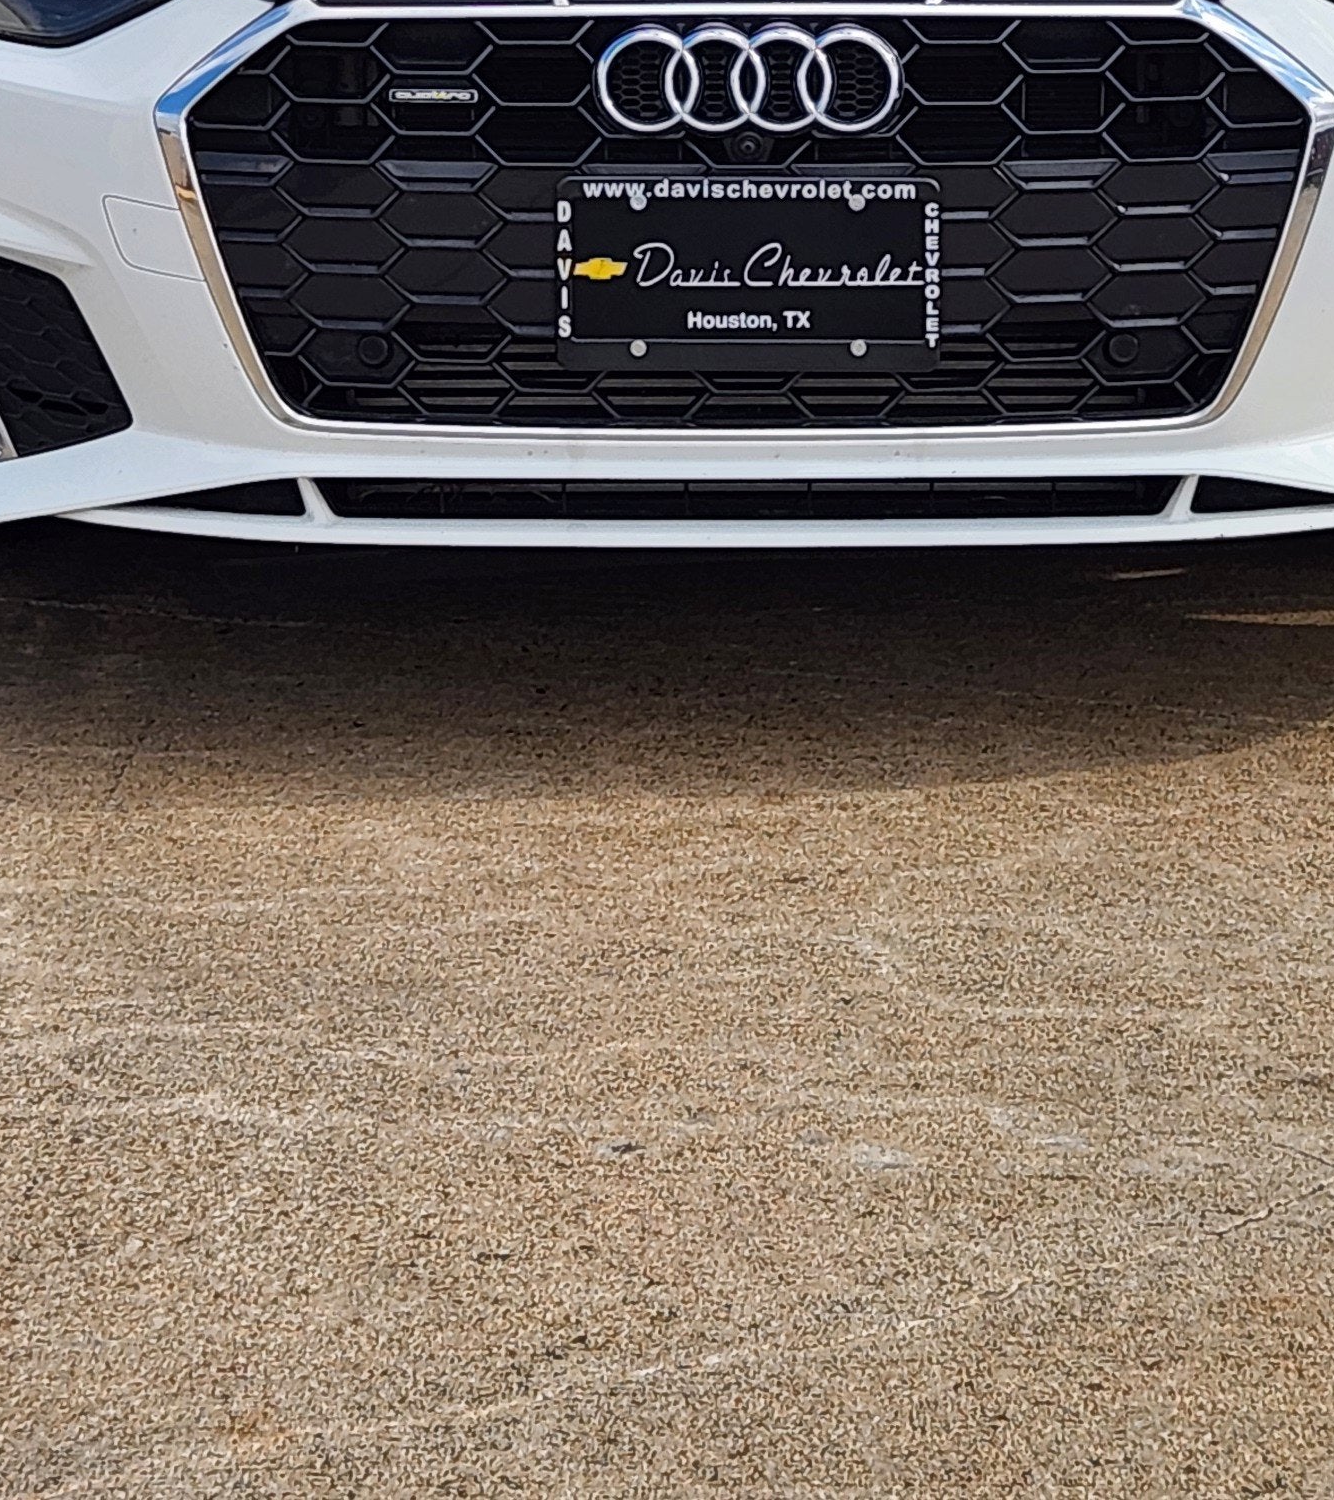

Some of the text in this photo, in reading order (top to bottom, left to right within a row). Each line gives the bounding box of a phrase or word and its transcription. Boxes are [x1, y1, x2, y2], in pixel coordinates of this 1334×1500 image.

[556, 199, 573, 338] DAVIS
[632, 242, 925, 288] Davis Chevrolet
[923, 201, 941, 348] CHEVROLET
[686, 310, 811, 332] Houston, TX
